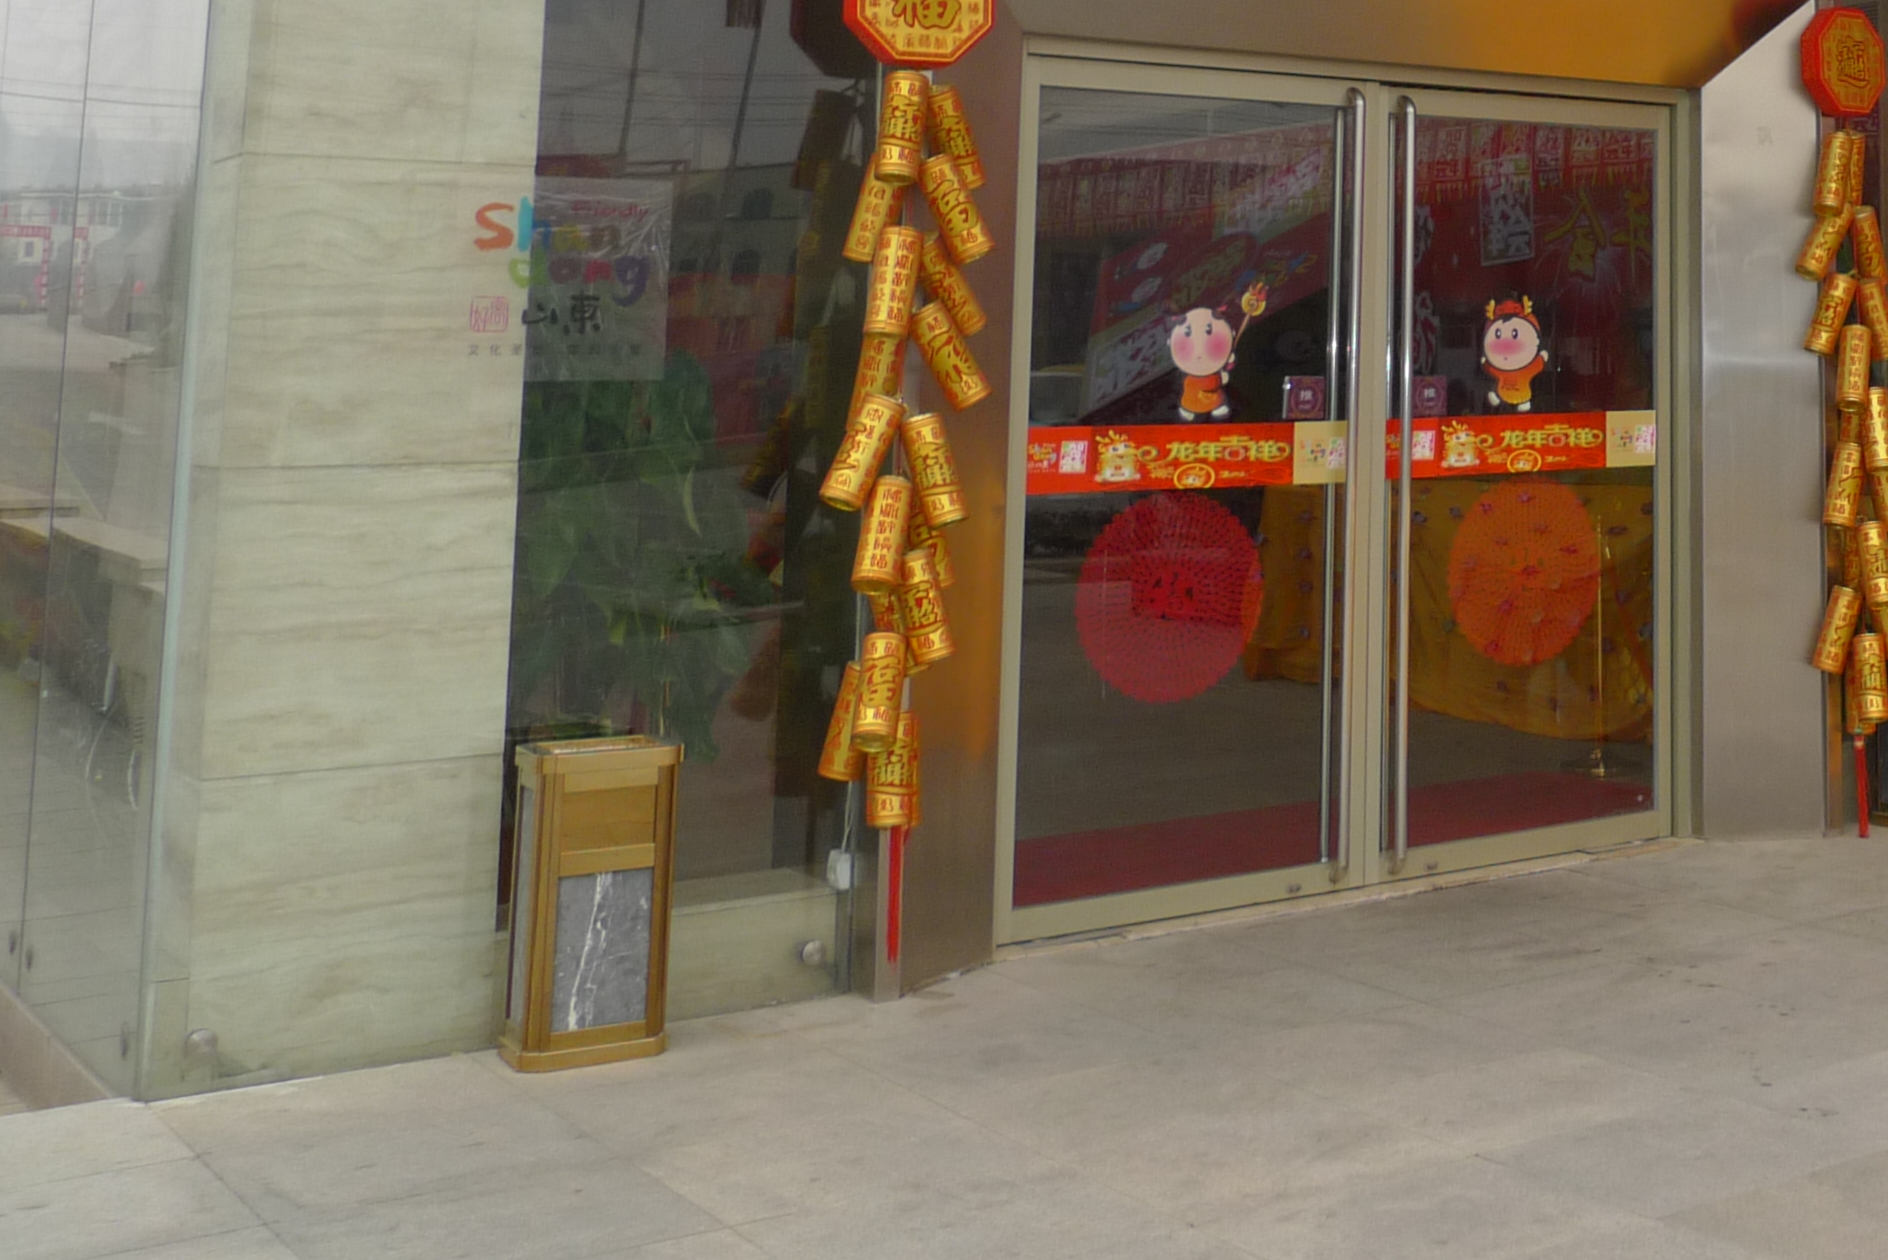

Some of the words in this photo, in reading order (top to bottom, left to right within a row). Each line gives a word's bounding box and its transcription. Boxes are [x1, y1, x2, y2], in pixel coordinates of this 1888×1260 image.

[1166, 435, 1291, 462] 龙年吉祥
[1501, 424, 1604, 448] 龙年吉祥
